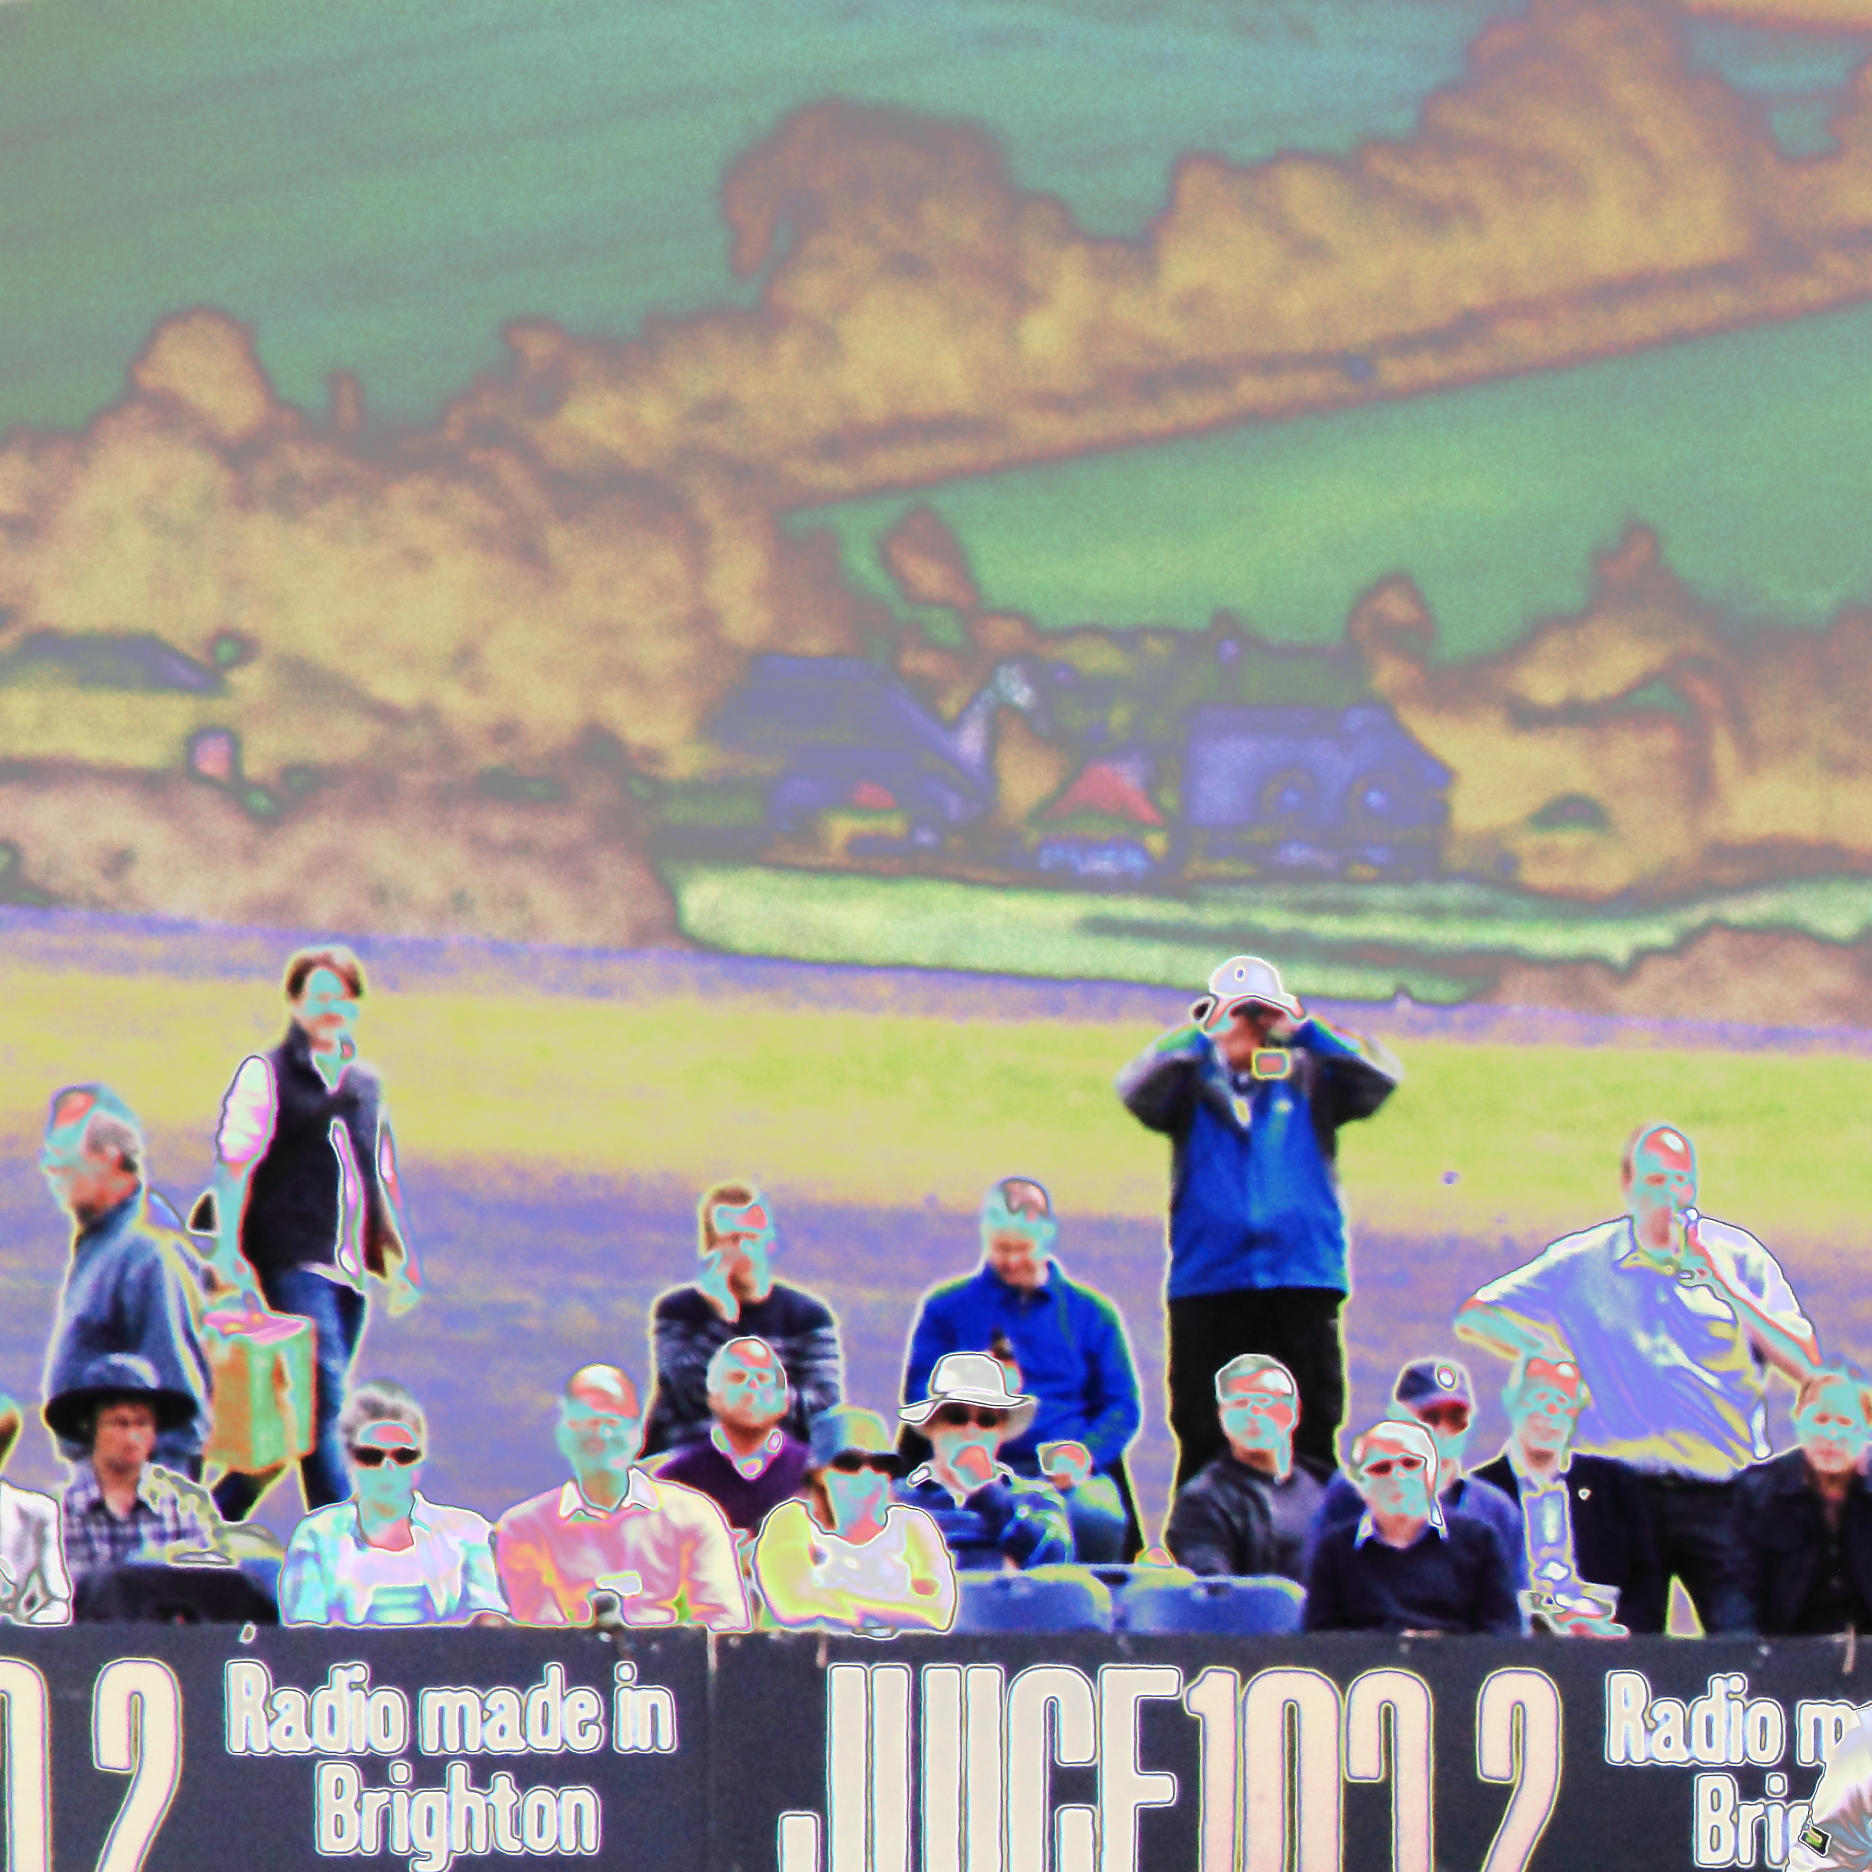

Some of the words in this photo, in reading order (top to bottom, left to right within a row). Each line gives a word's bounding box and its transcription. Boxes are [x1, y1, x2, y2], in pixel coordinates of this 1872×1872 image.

[225, 1659, 409, 1754] Radio
[420, 1661, 604, 1753] made
[613, 1661, 678, 1753] in
[1606, 1670, 1786, 1766] Radio
